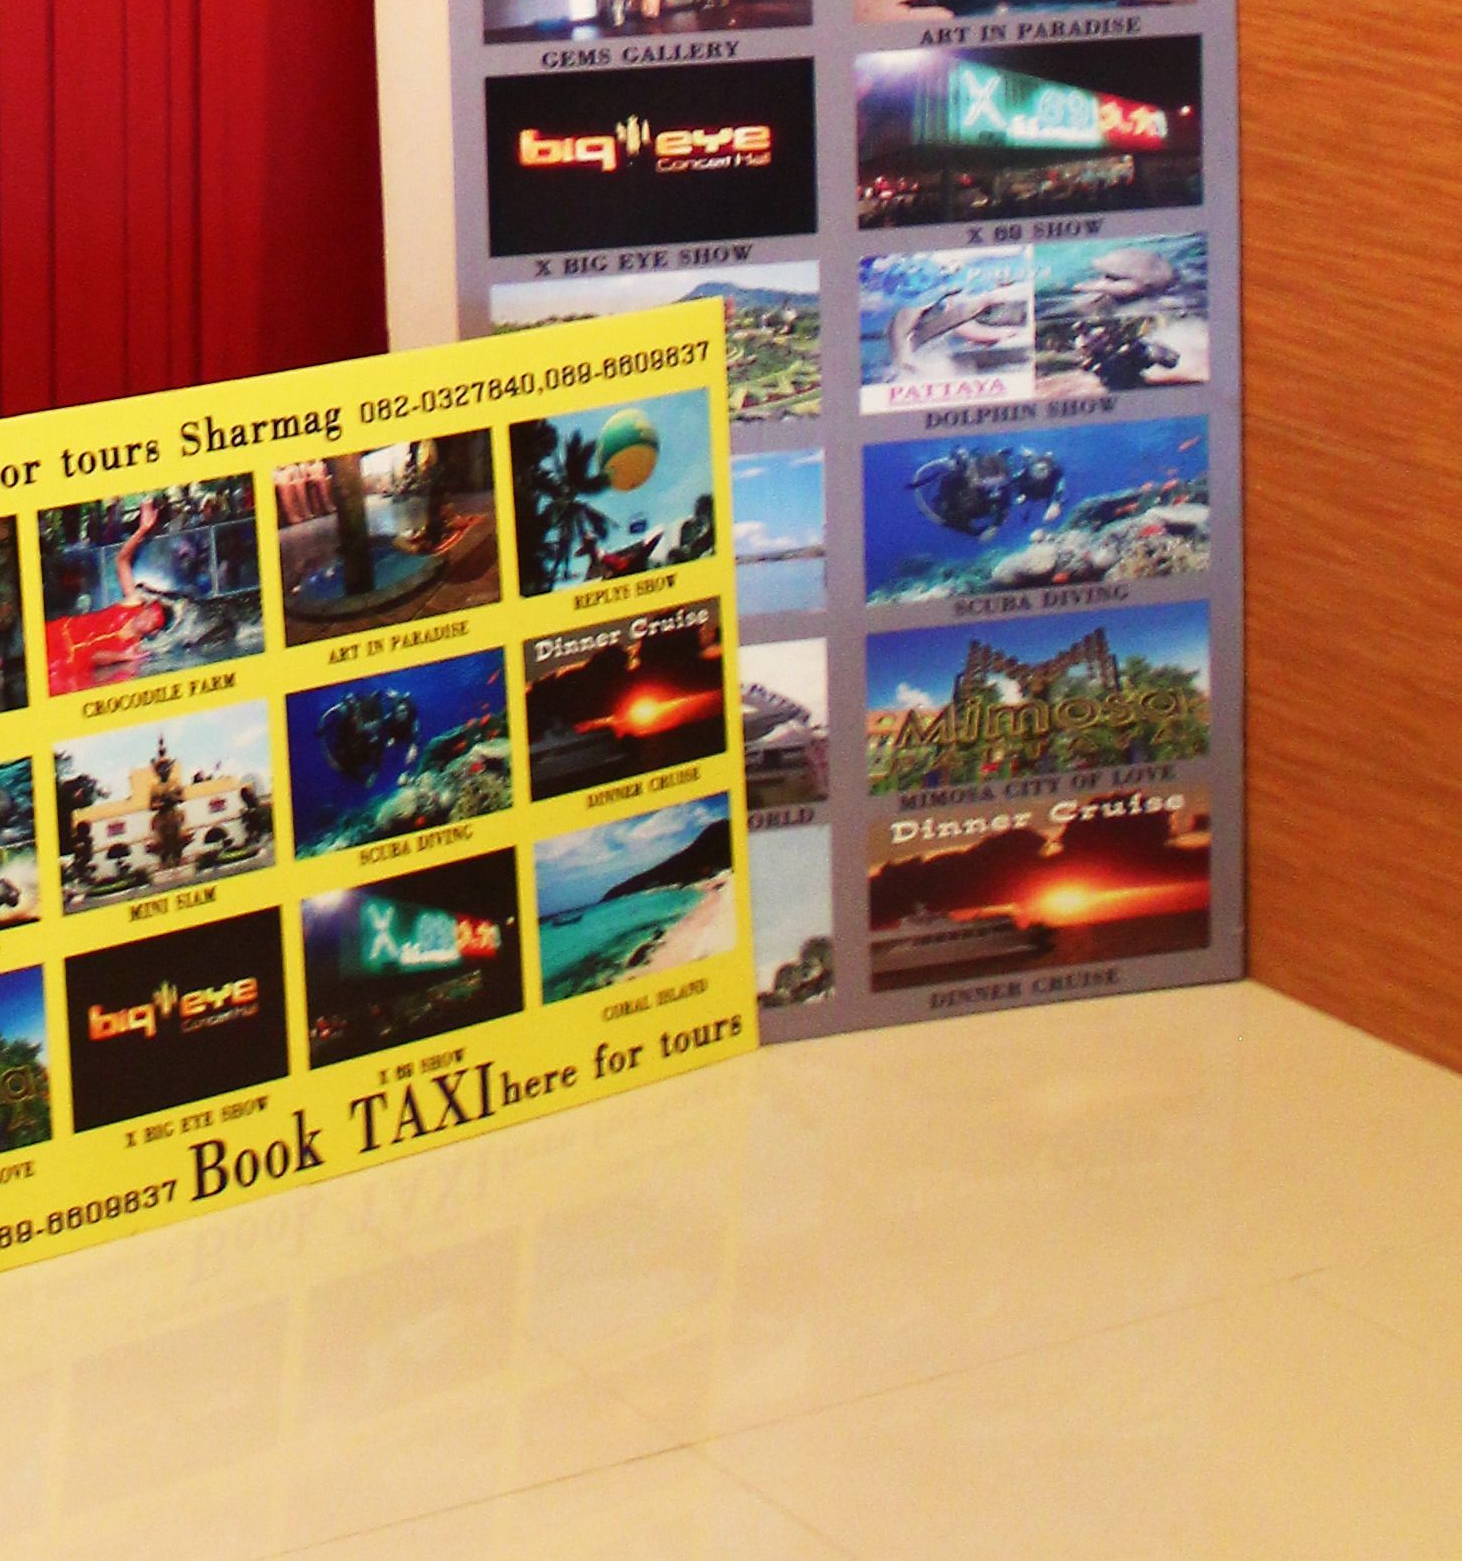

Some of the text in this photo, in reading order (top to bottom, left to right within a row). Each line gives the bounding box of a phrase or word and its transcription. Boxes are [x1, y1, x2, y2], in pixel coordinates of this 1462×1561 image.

[919, 15, 1141, 46] ART IN PARADISE
[541, 40, 740, 69] GEMS GALLERY
[1033, 218, 1105, 239] SHOW
[563, 253, 609, 275] BIG
[618, 249, 669, 271] EYE
[680, 244, 753, 266] SHOW
[924, 397, 1118, 430] DOLPHIN SHOW
[61, 437, 161, 480] tours
[179, 405, 342, 458] Sharmag
[951, 584, 1129, 617] SCUBA DIVING
[534, 607, 710, 663] Dinner Cruise
[82, 671, 237, 719] CROCODILE FARM
[748, 807, 815, 830] ORLD
[890, 792, 1186, 844] Dinner Cruise
[187, 1108, 325, 1204] Book
[348, 1060, 496, 1155] TAXI
[500, 1069, 578, 1107] here
[593, 1041, 644, 1080] for
[660, 1013, 743, 1059] tours
